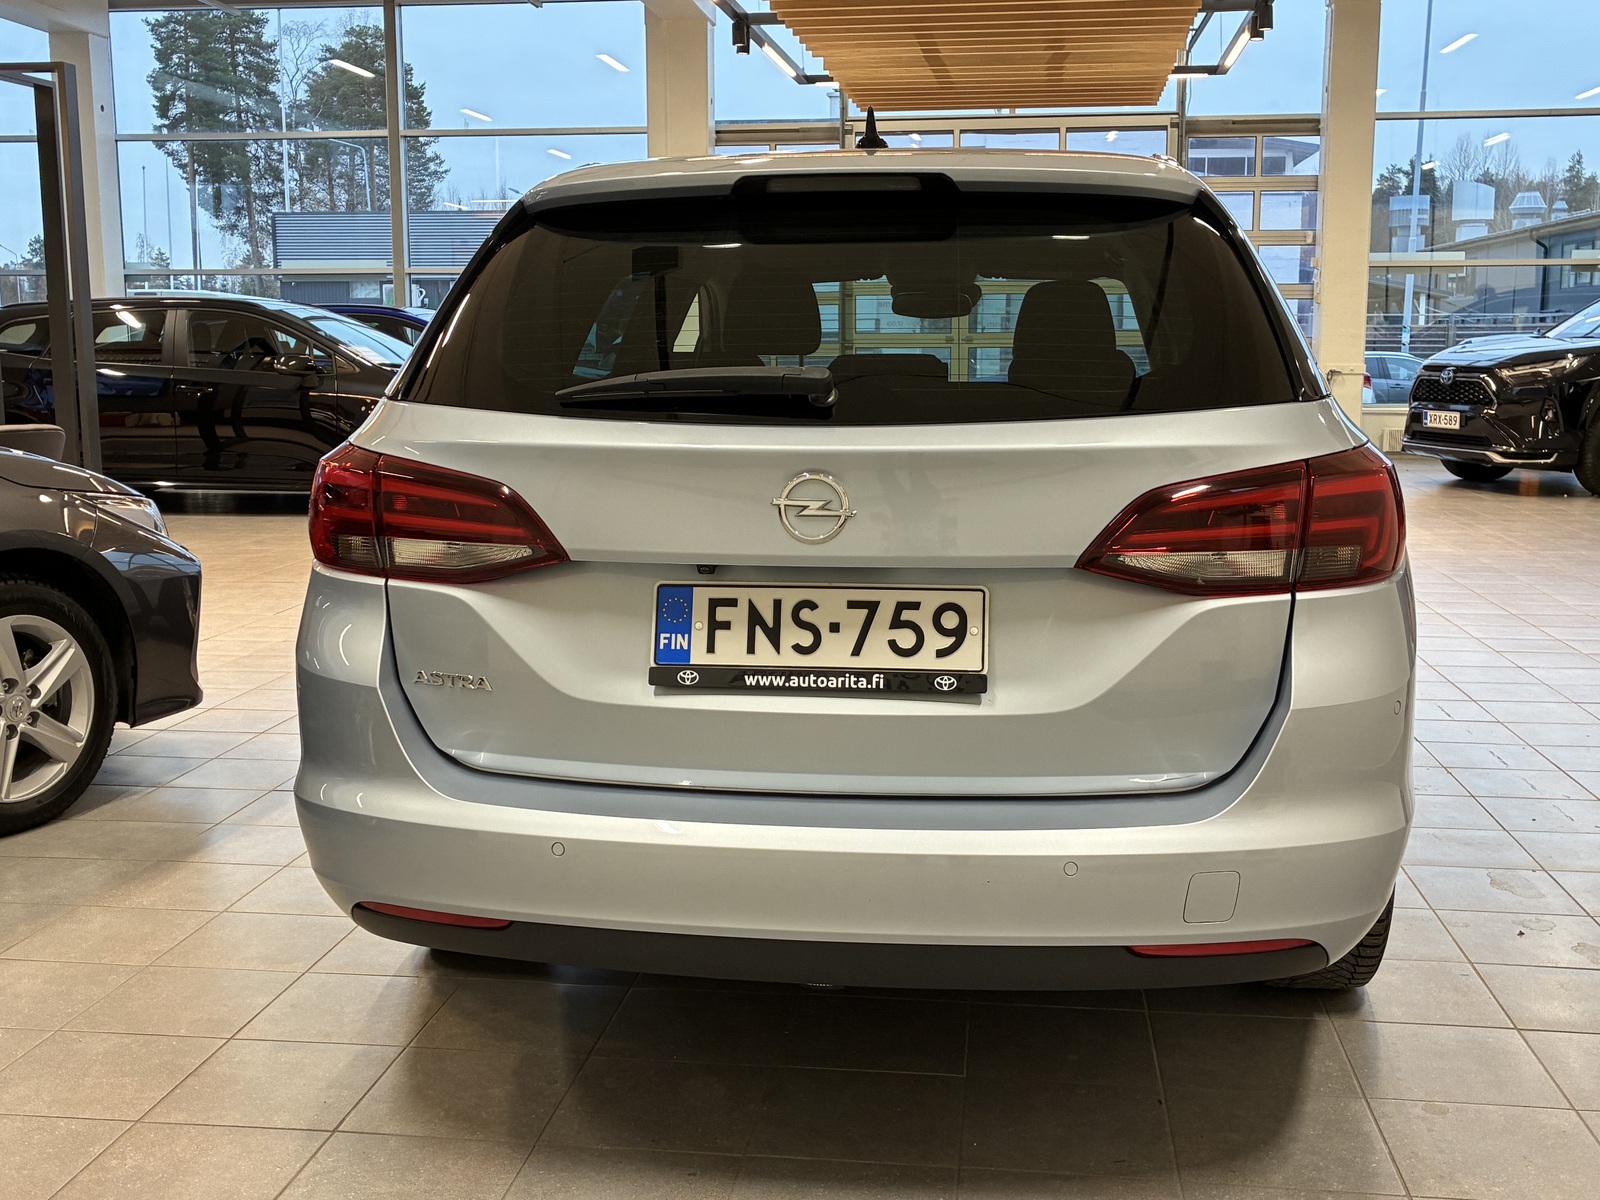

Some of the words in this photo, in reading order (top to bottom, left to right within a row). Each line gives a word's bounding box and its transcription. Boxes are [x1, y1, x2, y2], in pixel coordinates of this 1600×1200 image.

[659, 633, 689, 650] FIN
[413, 669, 493, 692] ASTRA
[744, 673, 884, 689] www.autoarita.fi
